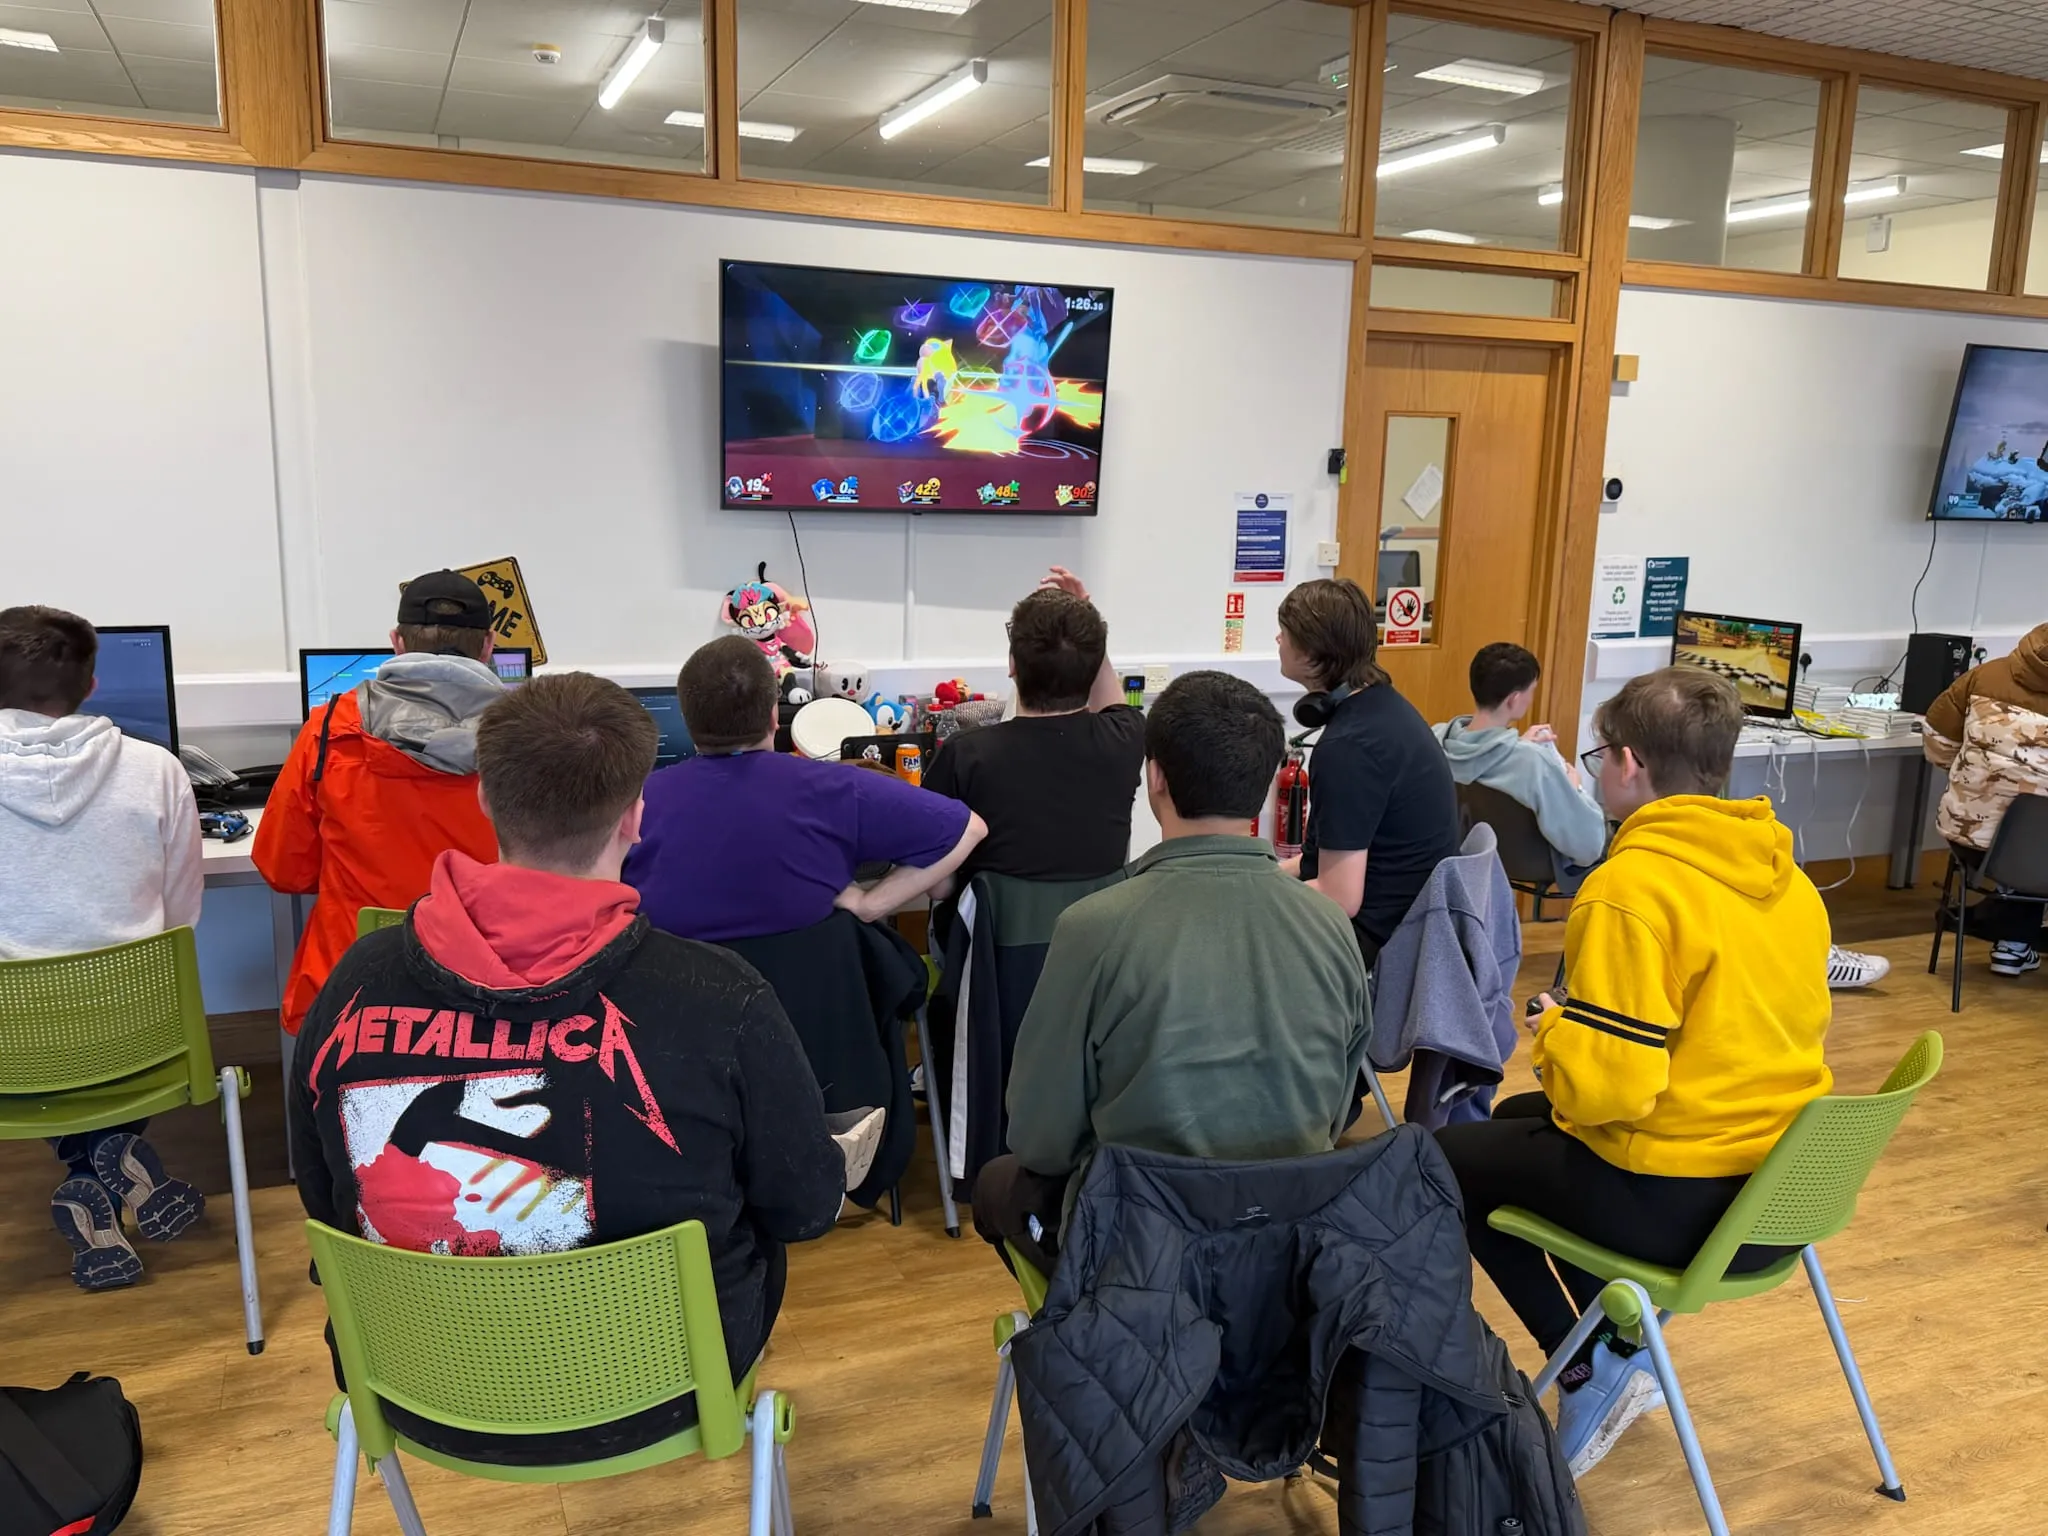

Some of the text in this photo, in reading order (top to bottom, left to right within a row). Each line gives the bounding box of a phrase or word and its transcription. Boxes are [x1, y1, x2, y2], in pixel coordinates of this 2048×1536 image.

[489, 600, 523, 638] ME
[903, 757, 920, 767] FAN
[309, 985, 682, 1156] METALLICA
